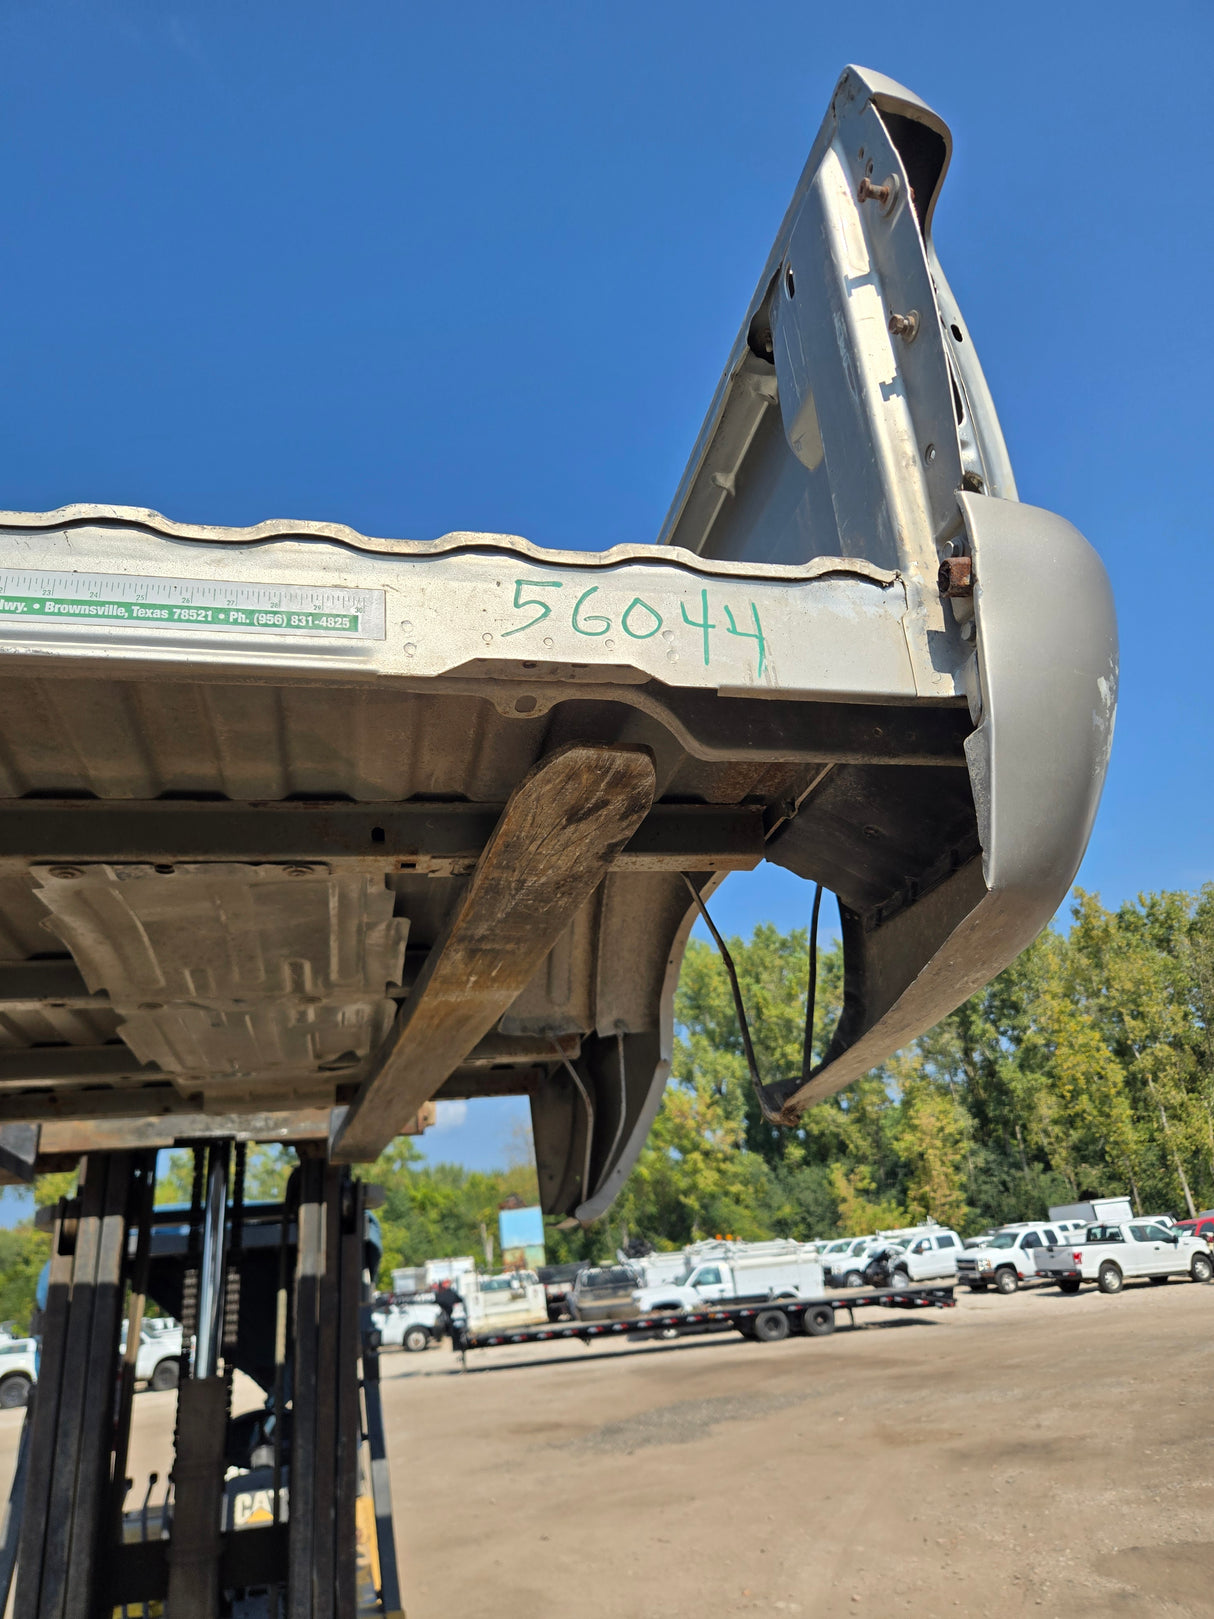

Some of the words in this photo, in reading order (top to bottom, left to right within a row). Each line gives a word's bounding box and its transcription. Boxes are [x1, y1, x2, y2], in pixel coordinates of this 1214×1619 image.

[89, 591, 98, 599] 24
[44, 601, 129, 619] Brownsville,
[131, 605, 169, 618] Texas
[172, 608, 213, 621] 78521
[229, 611, 250, 624] Ph.
[253, 613, 287, 627] (956)
[290, 615, 350, 629] 831-4825
[501, 579, 766, 678] 56044
